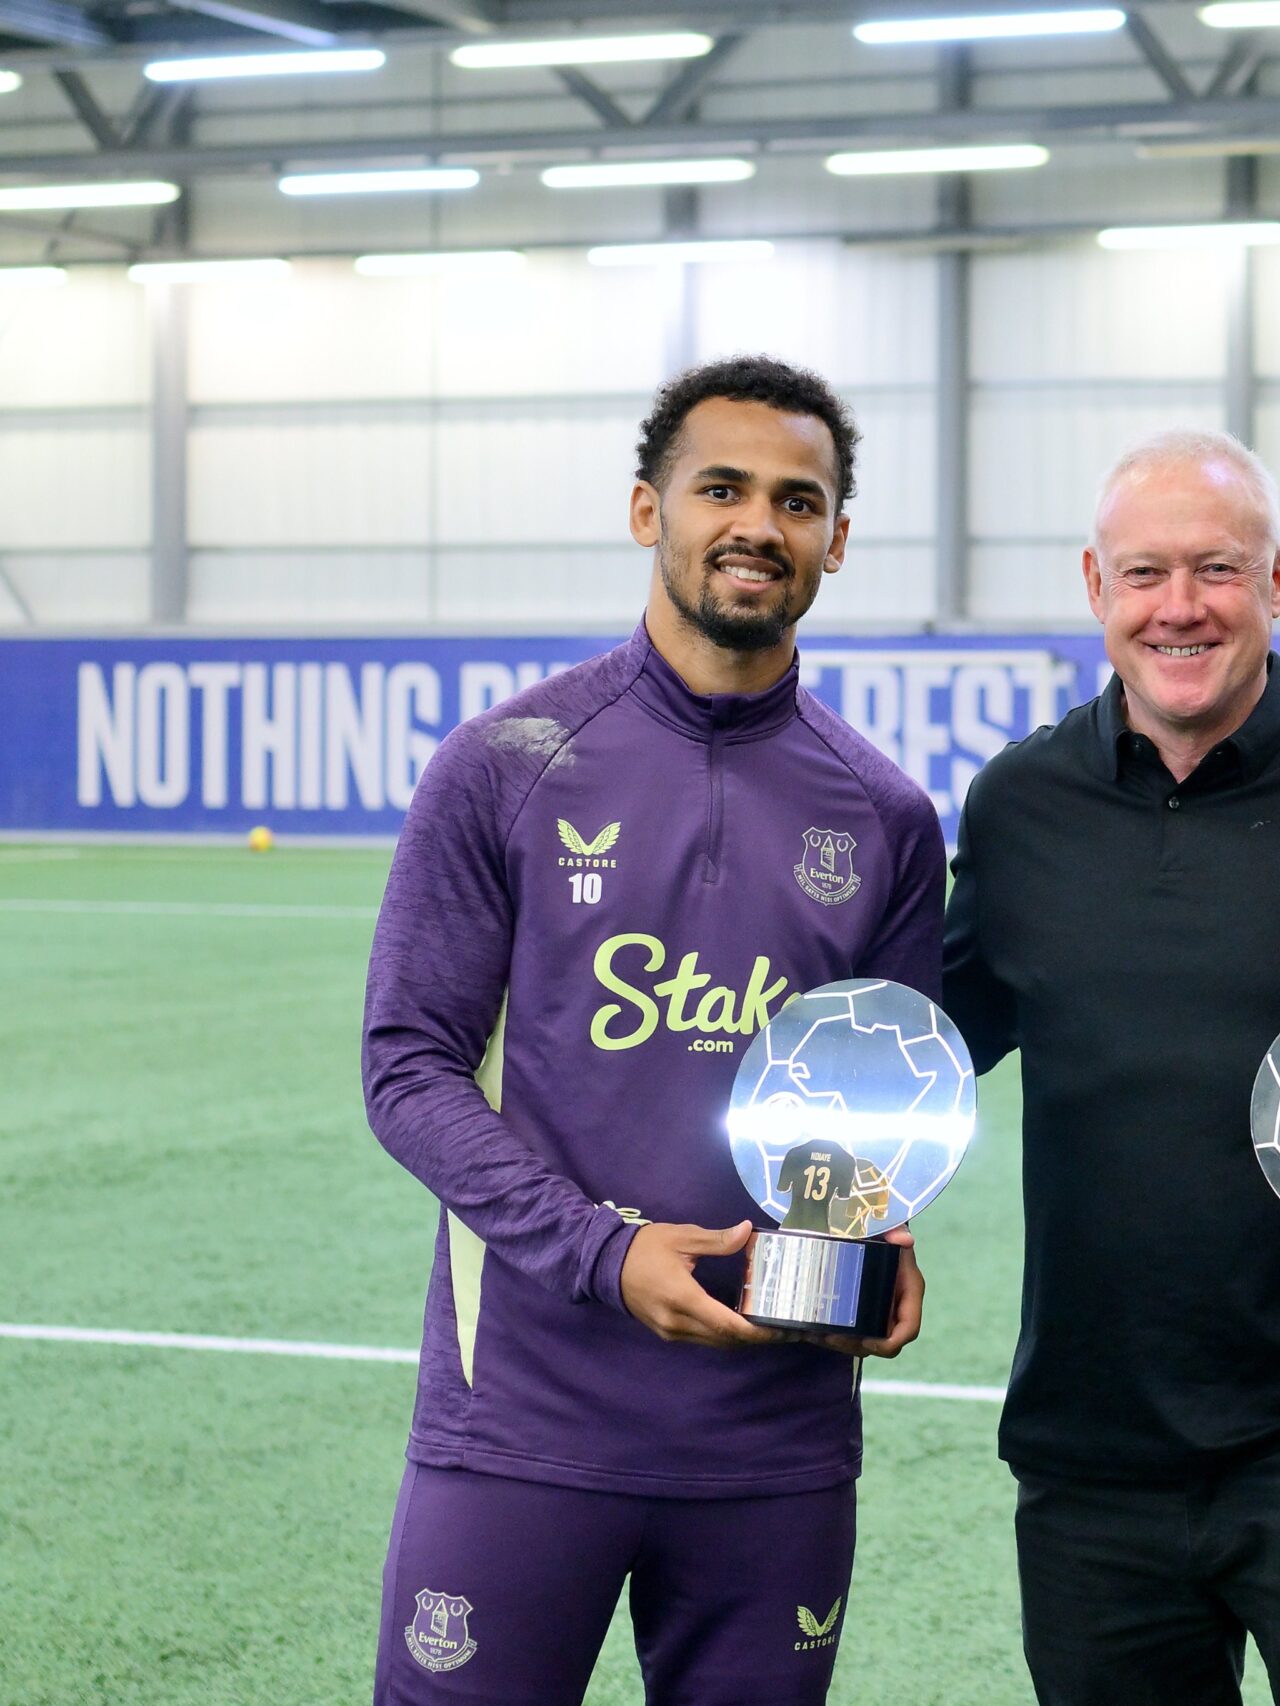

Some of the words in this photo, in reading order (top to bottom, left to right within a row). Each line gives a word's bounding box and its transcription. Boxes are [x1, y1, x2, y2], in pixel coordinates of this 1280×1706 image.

[77, 660, 441, 812] NOTHING
[558, 857, 618, 869] CASTORE
[810, 867, 844, 884] Everton
[567, 872, 603, 905] 10
[687, 1039, 735, 1054] .com
[803, 1164, 831, 1201] 13
[418, 1631, 458, 1650] Everton
